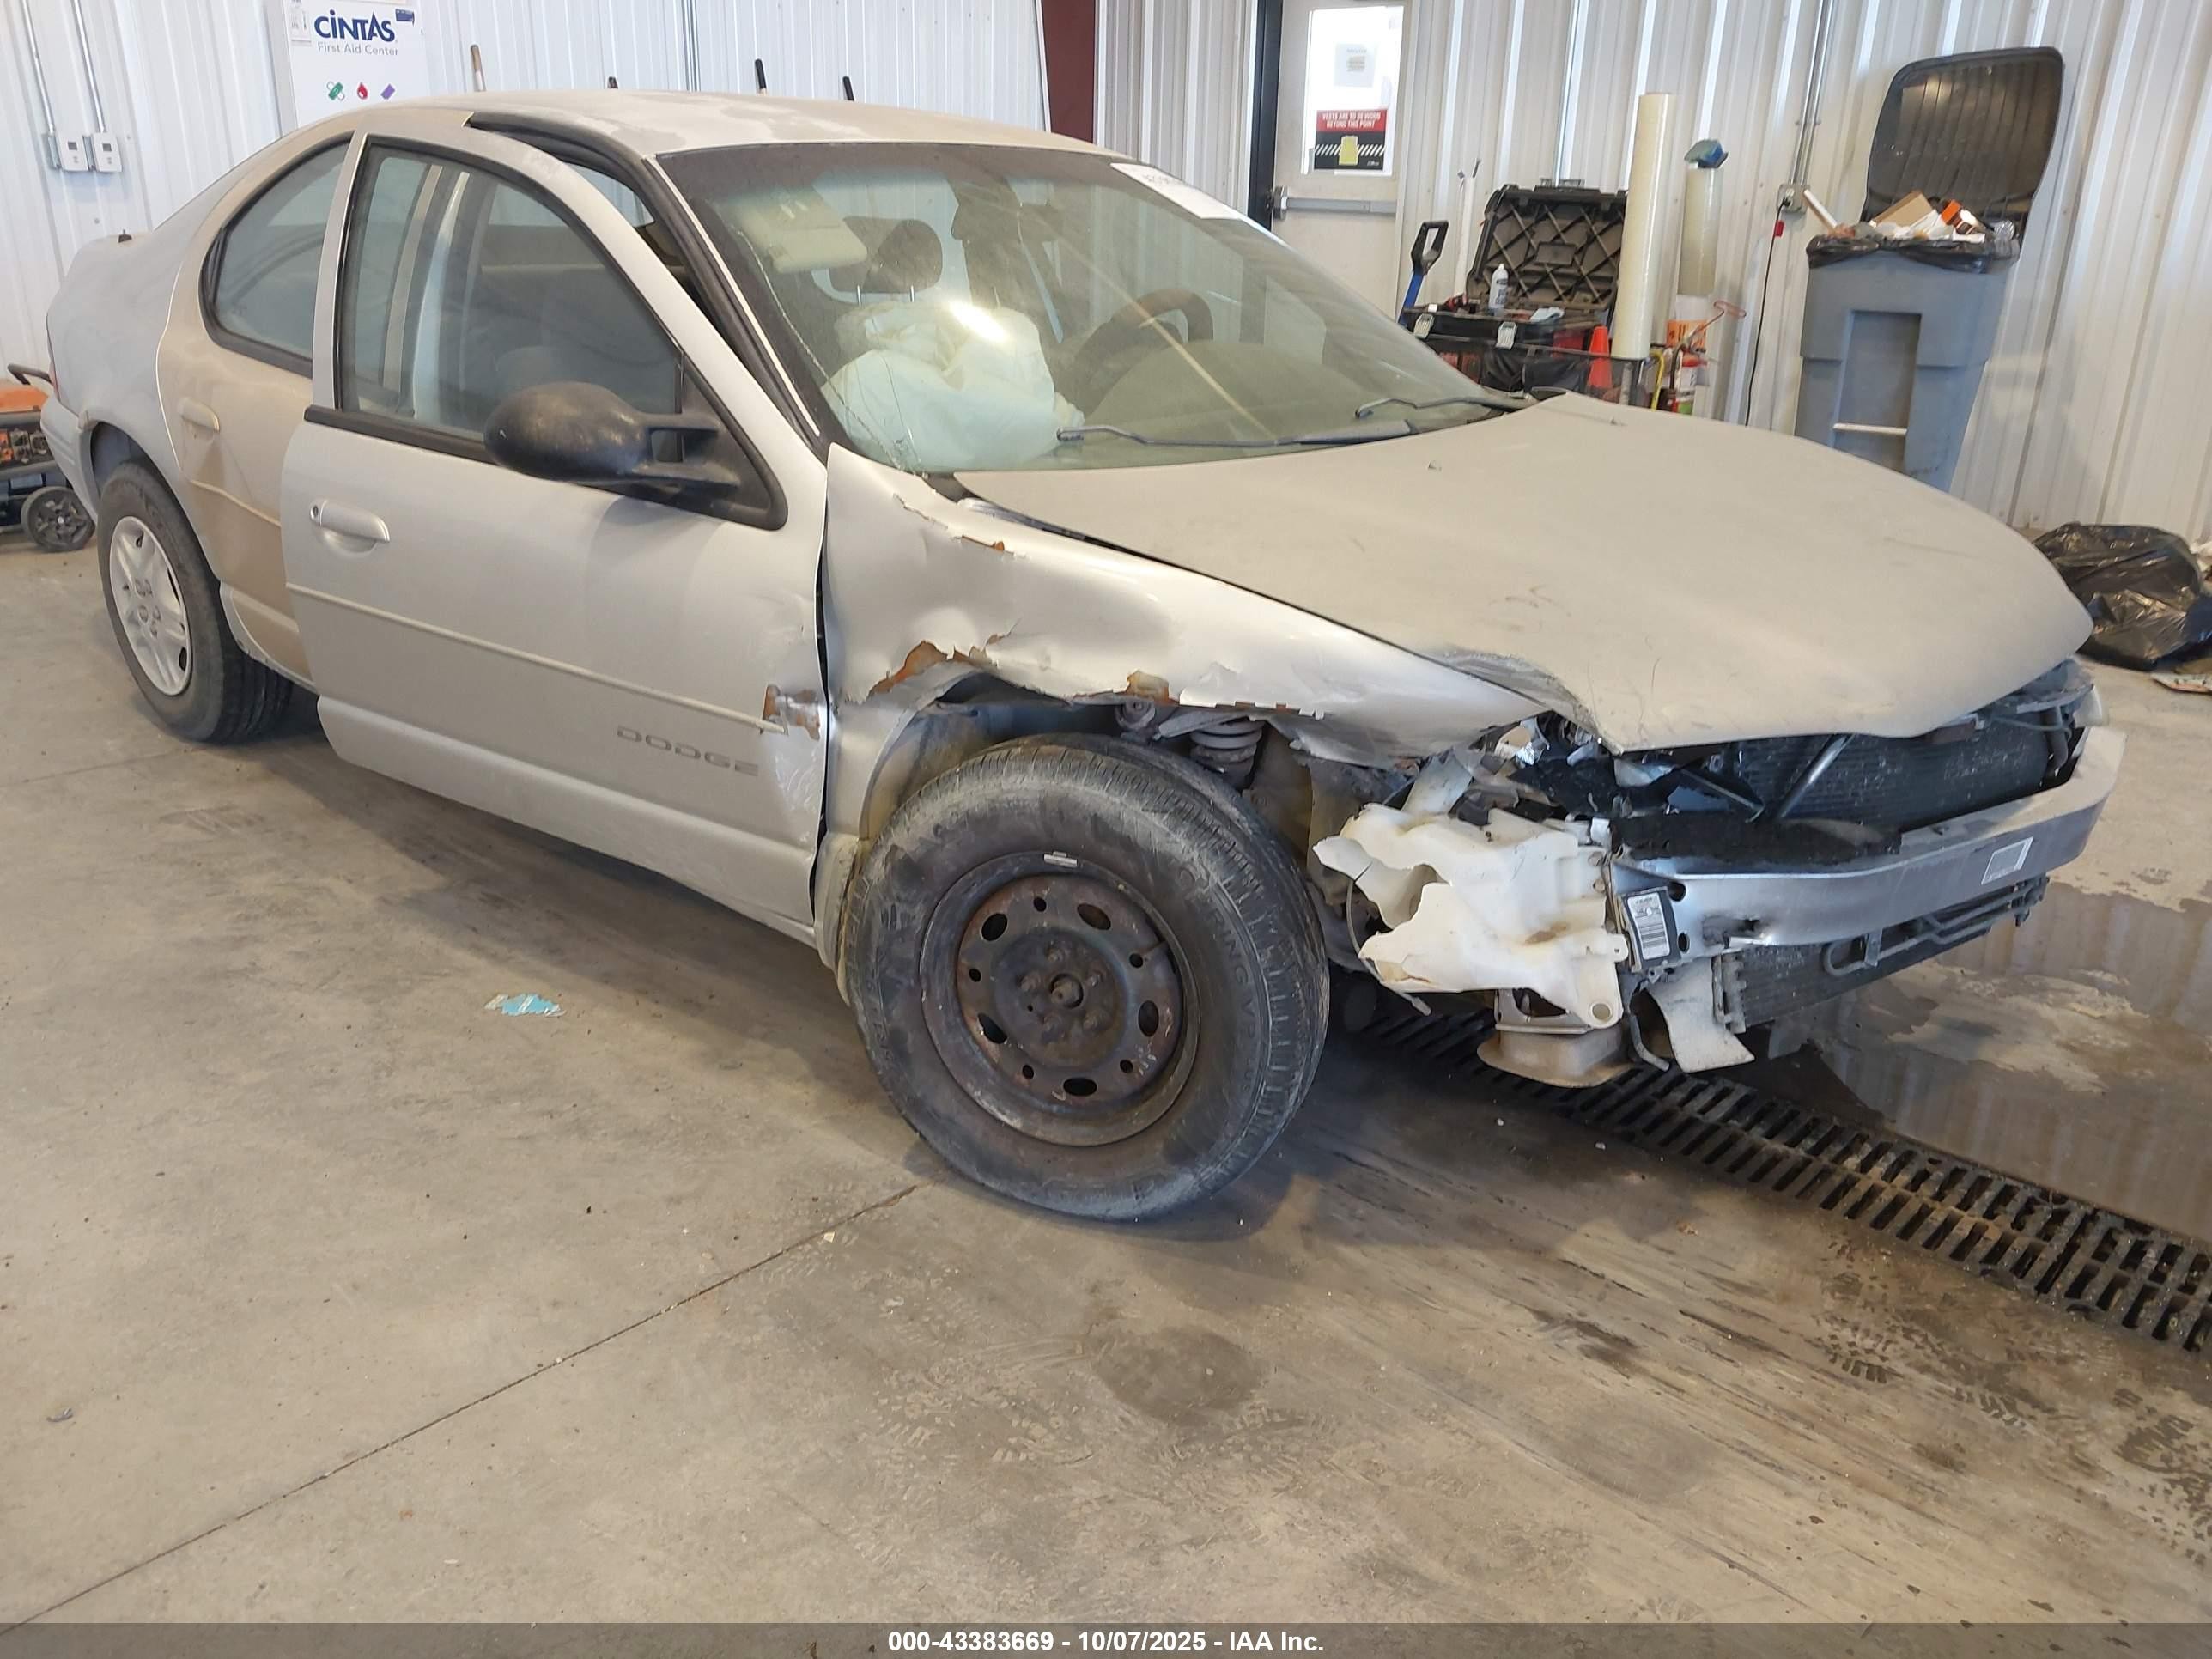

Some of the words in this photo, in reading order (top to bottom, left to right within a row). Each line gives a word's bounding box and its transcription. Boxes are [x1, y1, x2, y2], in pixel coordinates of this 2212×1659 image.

[318, 43, 340, 53] First
[343, 44, 361, 54] Aid
[365, 45, 398, 56] Center
[617, 726, 759, 777] DODGE
